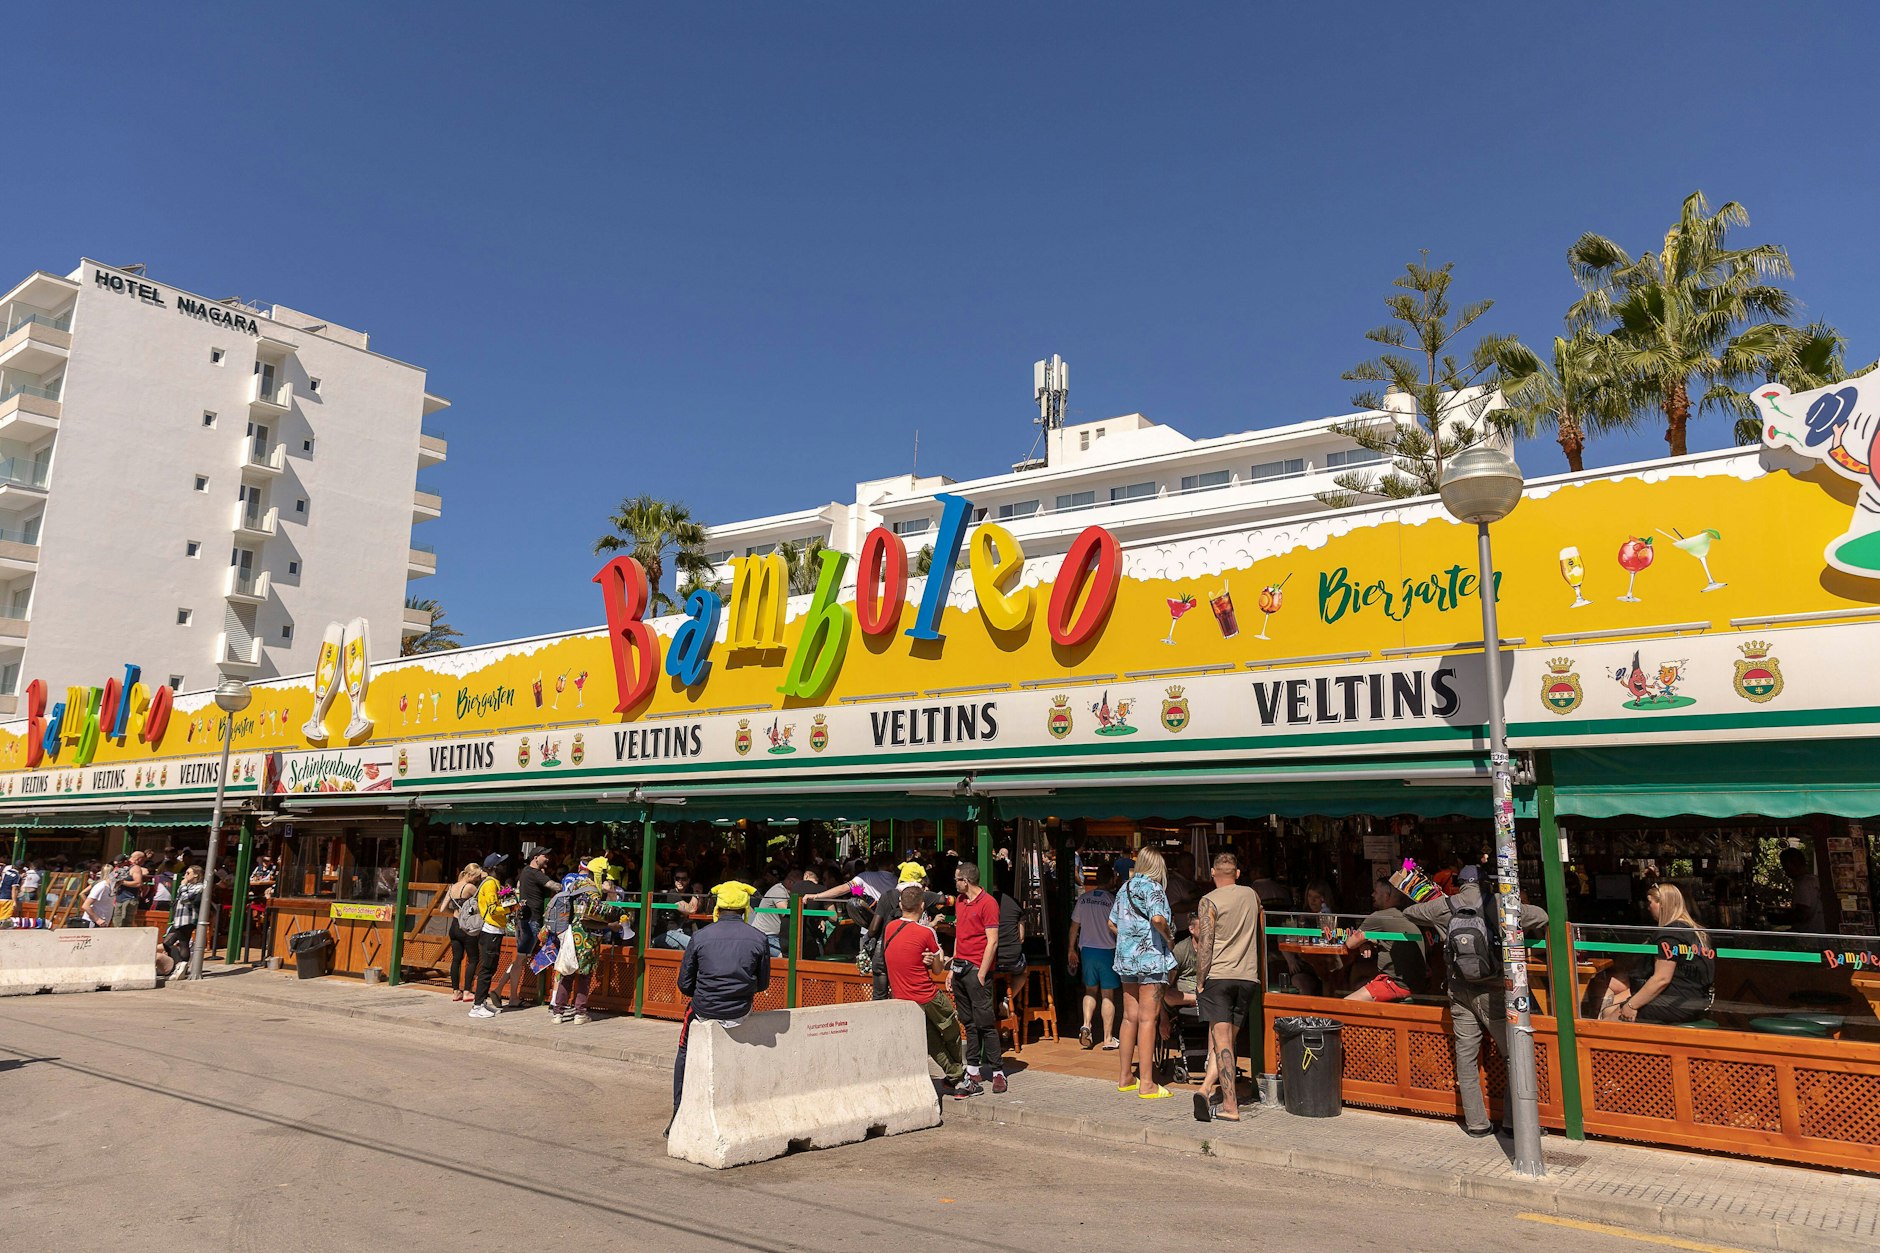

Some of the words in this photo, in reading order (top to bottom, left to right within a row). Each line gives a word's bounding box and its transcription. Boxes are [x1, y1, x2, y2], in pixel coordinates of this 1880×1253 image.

[94, 269, 165, 304] HOTEL
[176, 296, 259, 334] NIAGARA
[592, 492, 1123, 714] Bamboleo
[456, 685, 516, 720] Biergarten
[1251, 667, 1461, 727] VELTINS
[26, 663, 174, 768] Bamboleo
[218, 716, 255, 742] Bgarten
[870, 701, 999, 748] VELTINS
[428, 740, 495, 774] VELTINS
[613, 724, 704, 762] VELTINS
[21, 775, 48, 794] VELTINS
[92, 769, 125, 790] VELTINS
[180, 761, 220, 785] VELTINS
[288, 752, 365, 791] Schinkenbude
[1661, 941, 1715, 961] Bamboleo
[1823, 949, 1880, 970] Bambole
